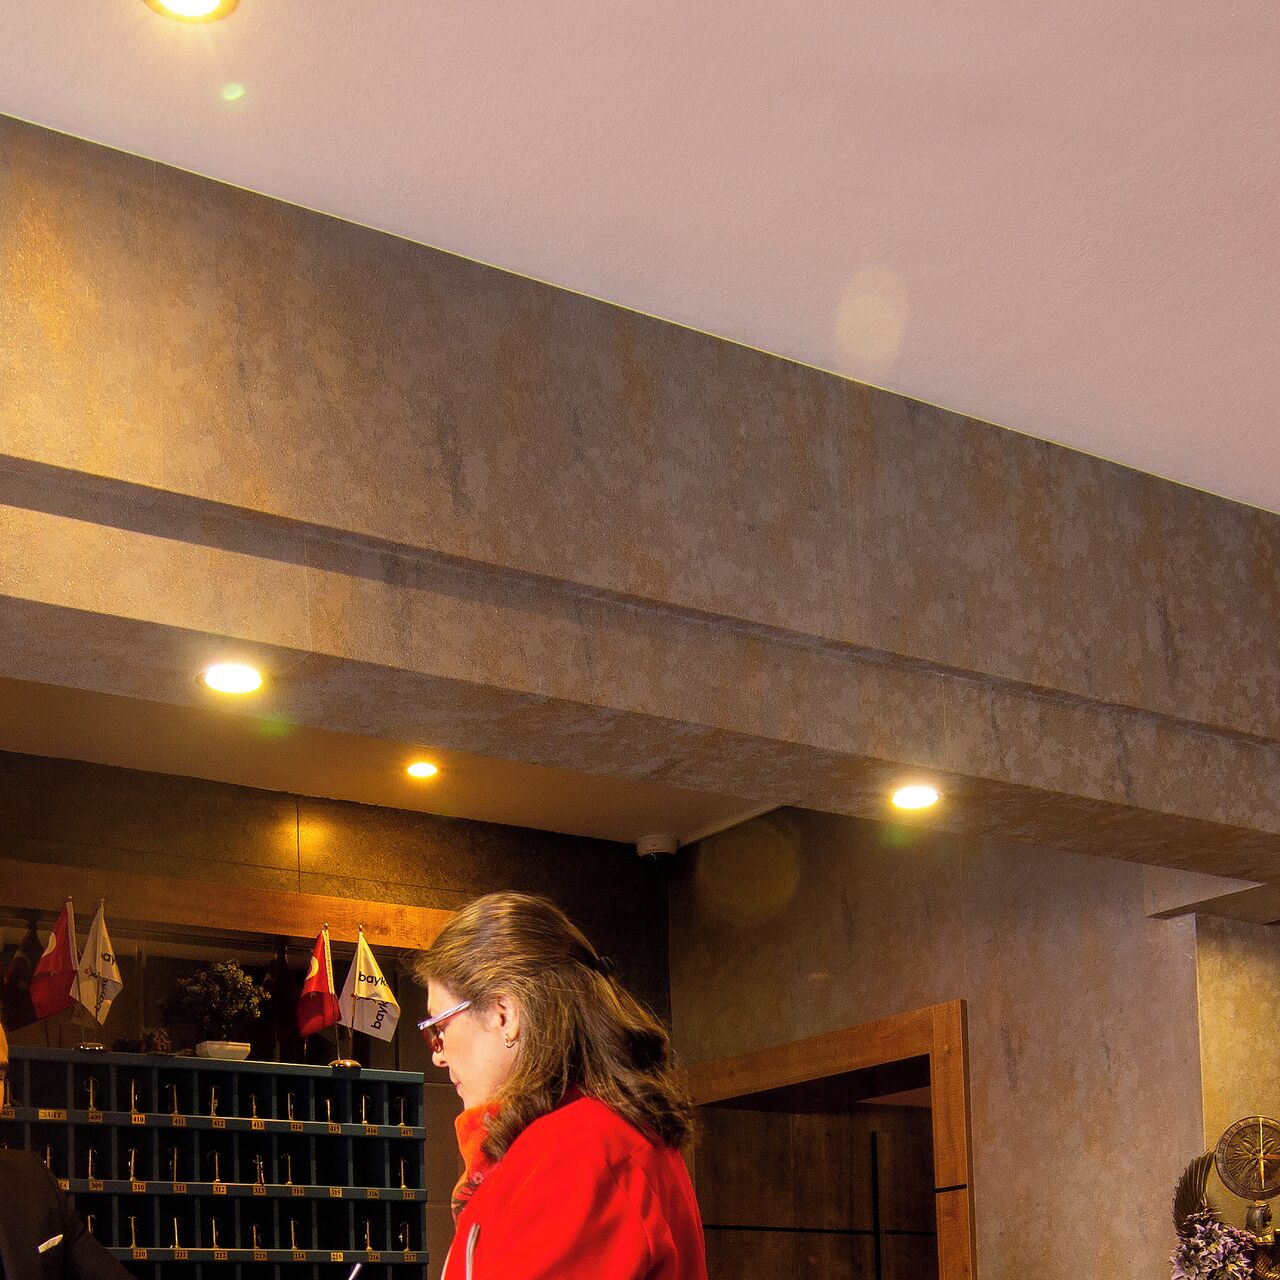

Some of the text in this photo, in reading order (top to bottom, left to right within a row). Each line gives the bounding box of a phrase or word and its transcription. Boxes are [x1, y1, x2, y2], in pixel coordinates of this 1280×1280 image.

[132, 1115, 145, 1124] 410
[173, 1117, 185, 1125] 411
[329, 1124, 341, 1133] 415
[174, 1184, 186, 1192] 311
[212, 1185, 225, 1194] 312
[292, 1187, 304, 1195] 314
[330, 1188, 342, 1197] 315
[402, 1191, 414, 1199] 317
[133, 1251, 146, 1259] 210
[175, 1251, 187, 1259] 211
[215, 1251, 227, 1259] 212
[293, 1252, 305, 1260] 214
[331, 1252, 343, 1261] 215
